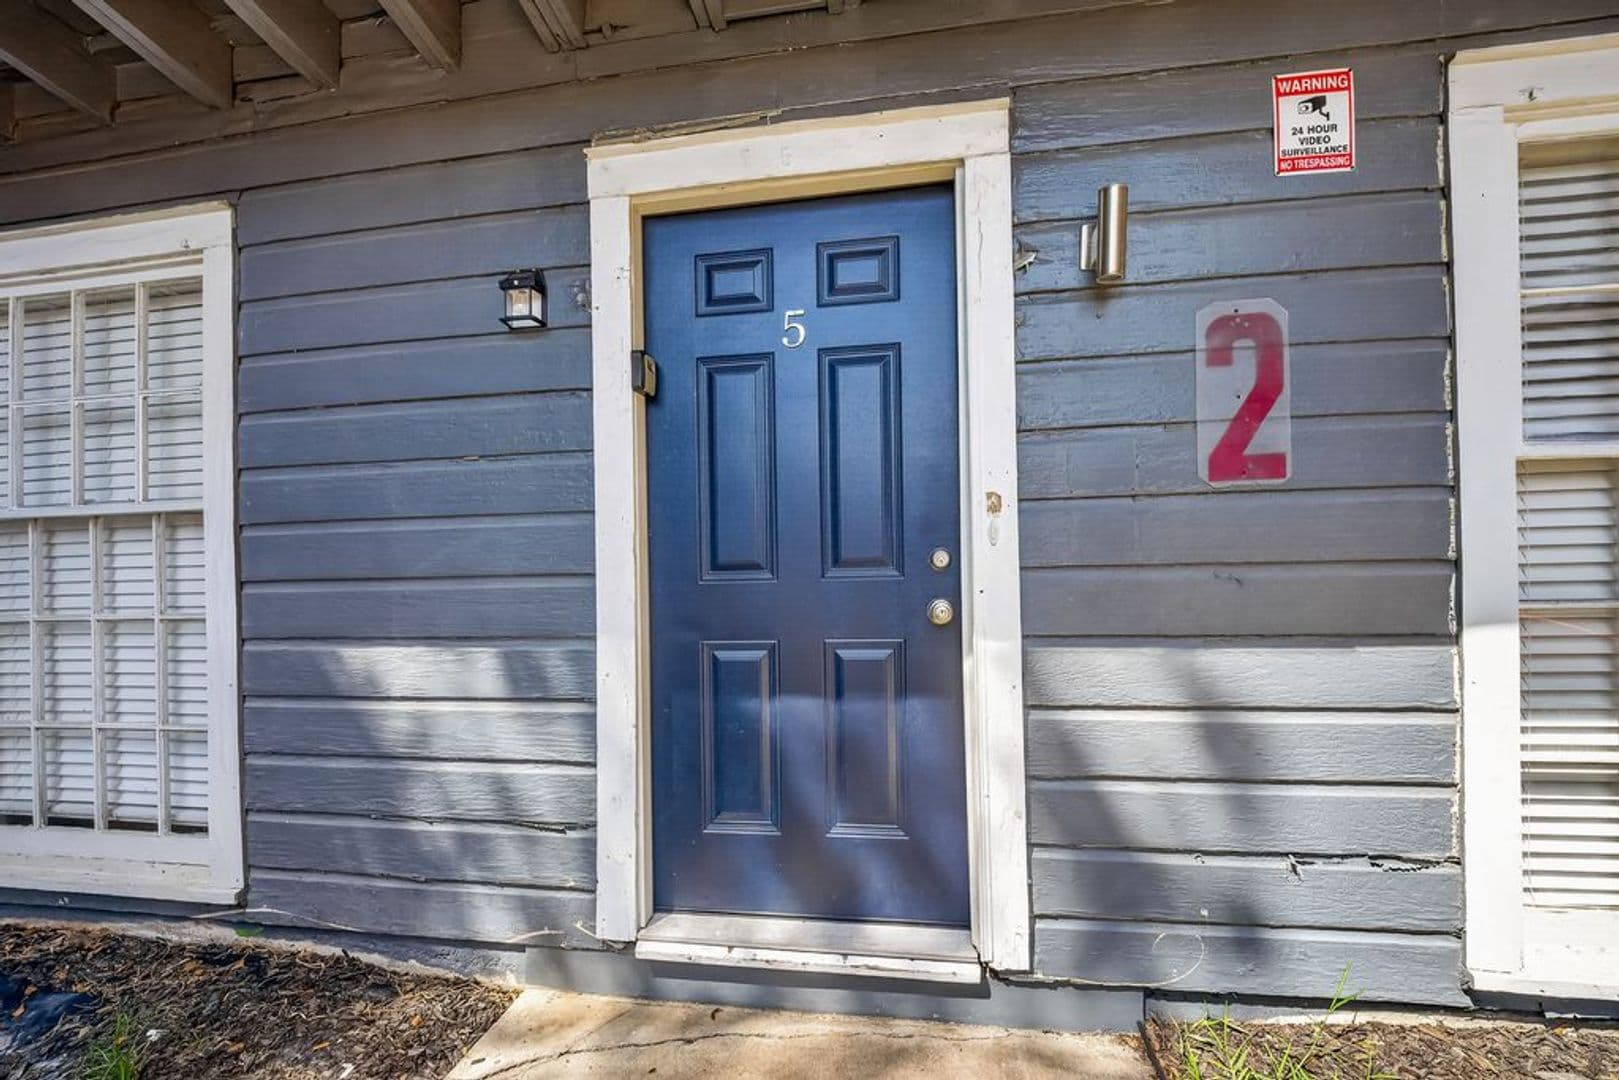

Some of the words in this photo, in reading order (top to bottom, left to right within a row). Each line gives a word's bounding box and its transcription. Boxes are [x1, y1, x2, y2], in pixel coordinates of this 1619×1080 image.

[1277, 75, 1349, 93] WARNING
[1291, 126, 1304, 136] 24
[1307, 123, 1338, 135] HOUR
[1298, 135, 1331, 145] VIDEO
[1281, 144, 1348, 157] SURVEILLANCE
[1280, 160, 1293, 169] NO
[1294, 156, 1350, 168] TRESPASSING
[782, 309, 805, 348] 5
[1205, 312, 1287, 482] 2
